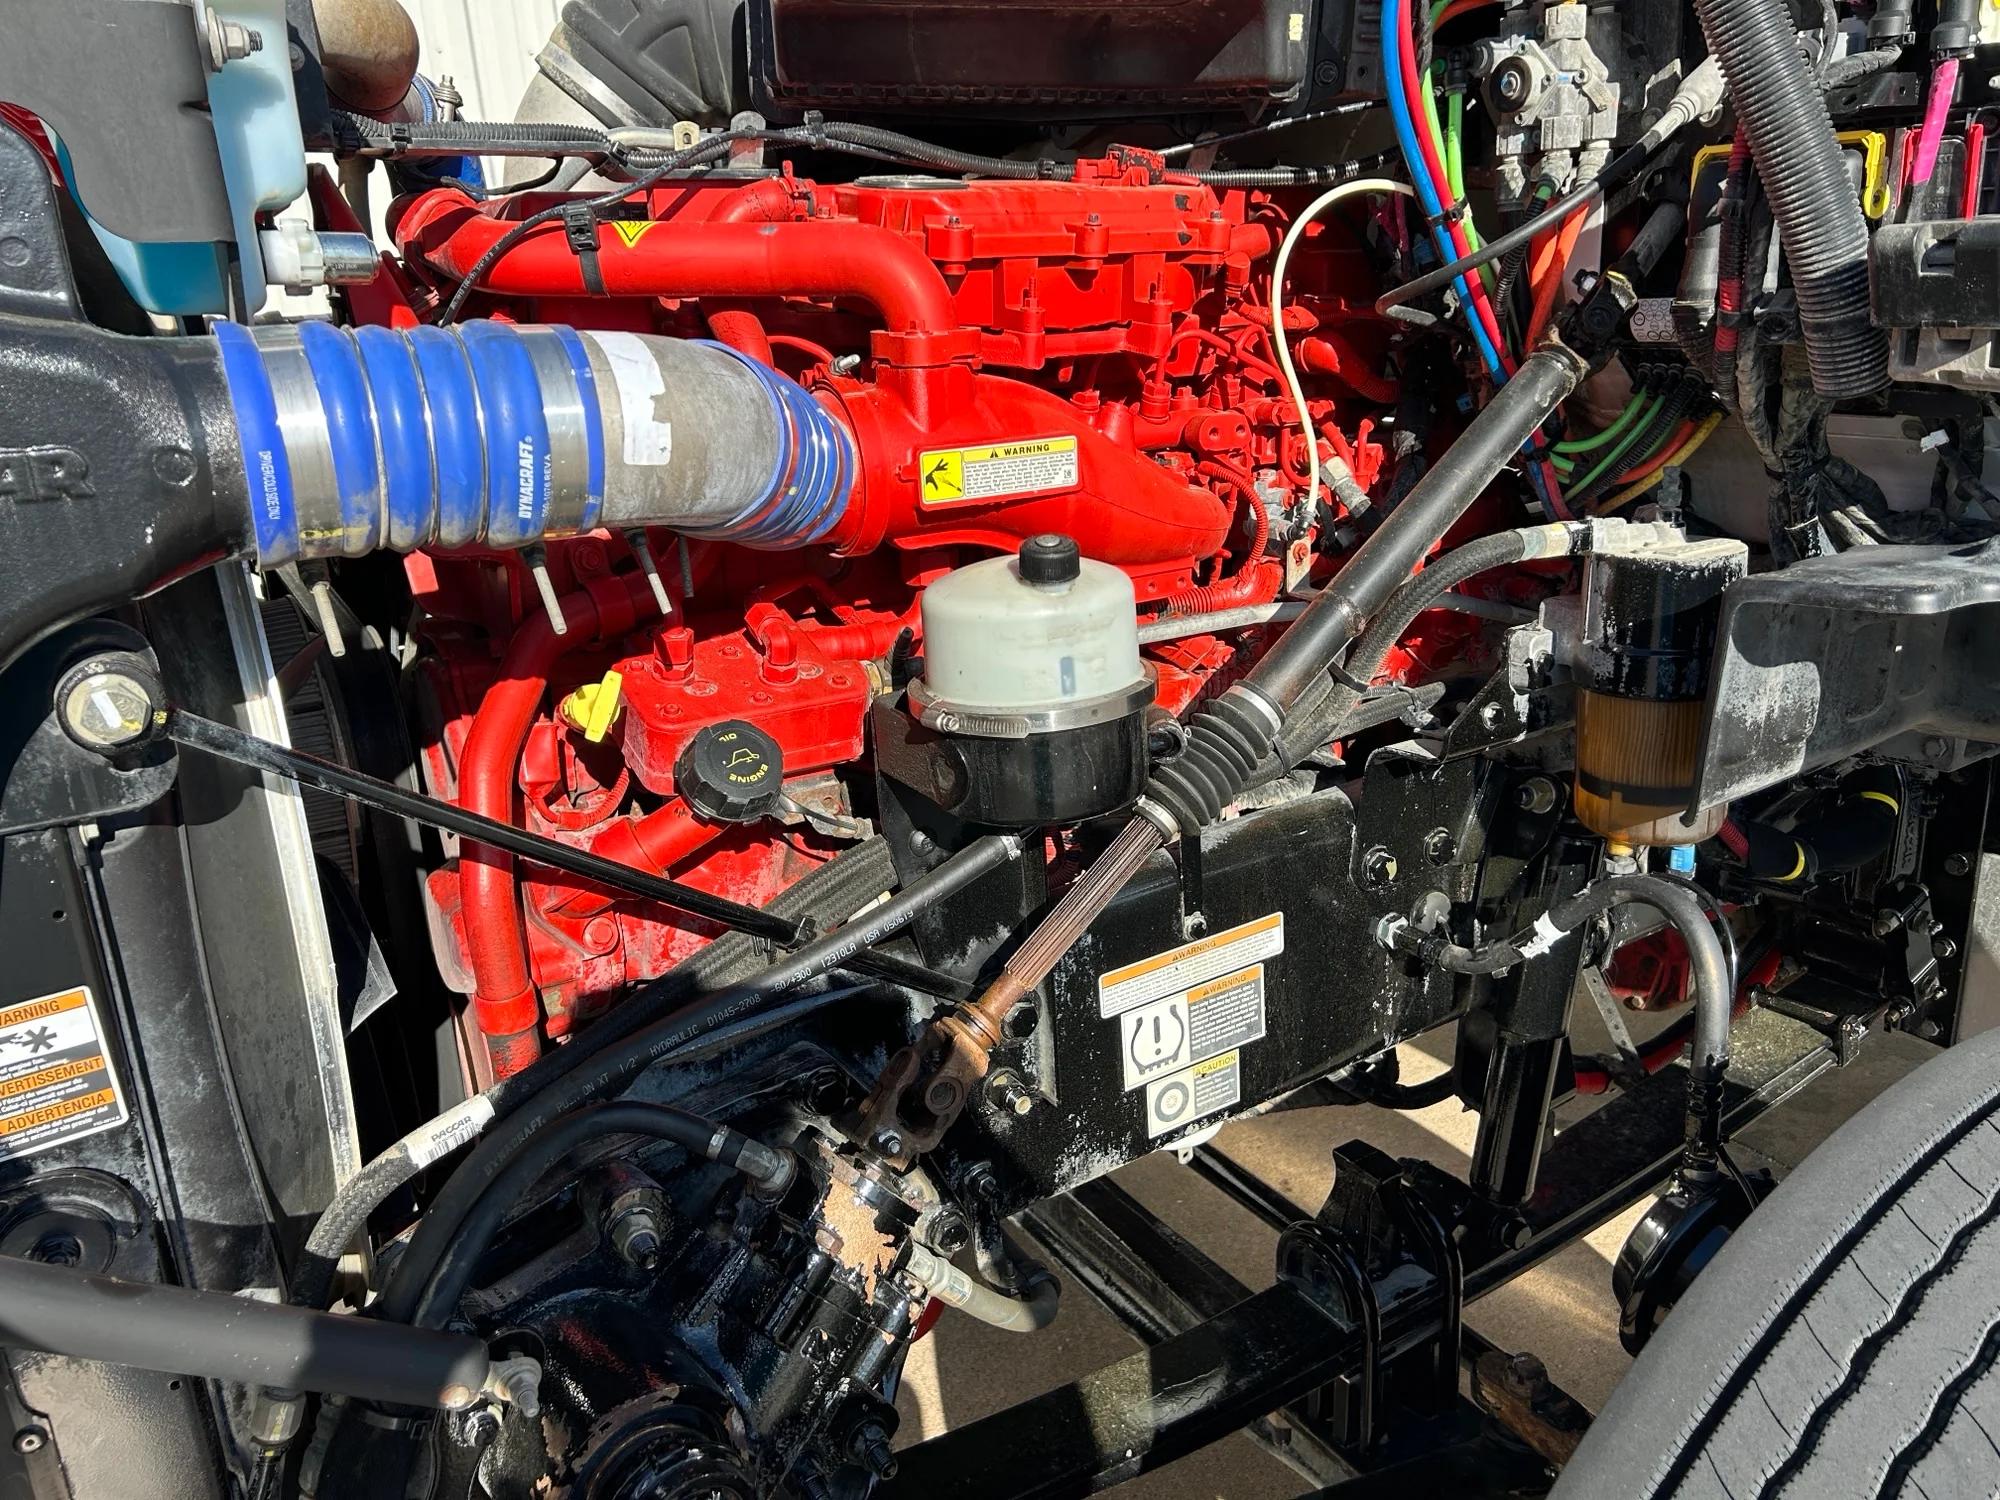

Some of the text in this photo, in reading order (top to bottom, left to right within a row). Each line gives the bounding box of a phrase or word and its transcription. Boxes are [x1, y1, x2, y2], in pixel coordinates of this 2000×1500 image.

[1004, 444, 1050, 456] WARNING
[719, 733, 737, 742] OIL
[729, 764, 769, 783] ENGINE
[1178, 940, 1217, 960] WARNING
[1210, 974, 1246, 992] WARNING
[650, 1024, 700, 1057] HYDRAULIC
[706, 994, 762, 1028] D1045-2708
[821, 942, 857, 968] 12310LA
[864, 930, 881, 944] USA
[0, 1000, 60, 1026] ARNING
[1202, 1055, 1236, 1072] CAUTION
[8, 1094, 106, 1132] ADVERTENCIA
[431, 1116, 472, 1142] PACCAR
